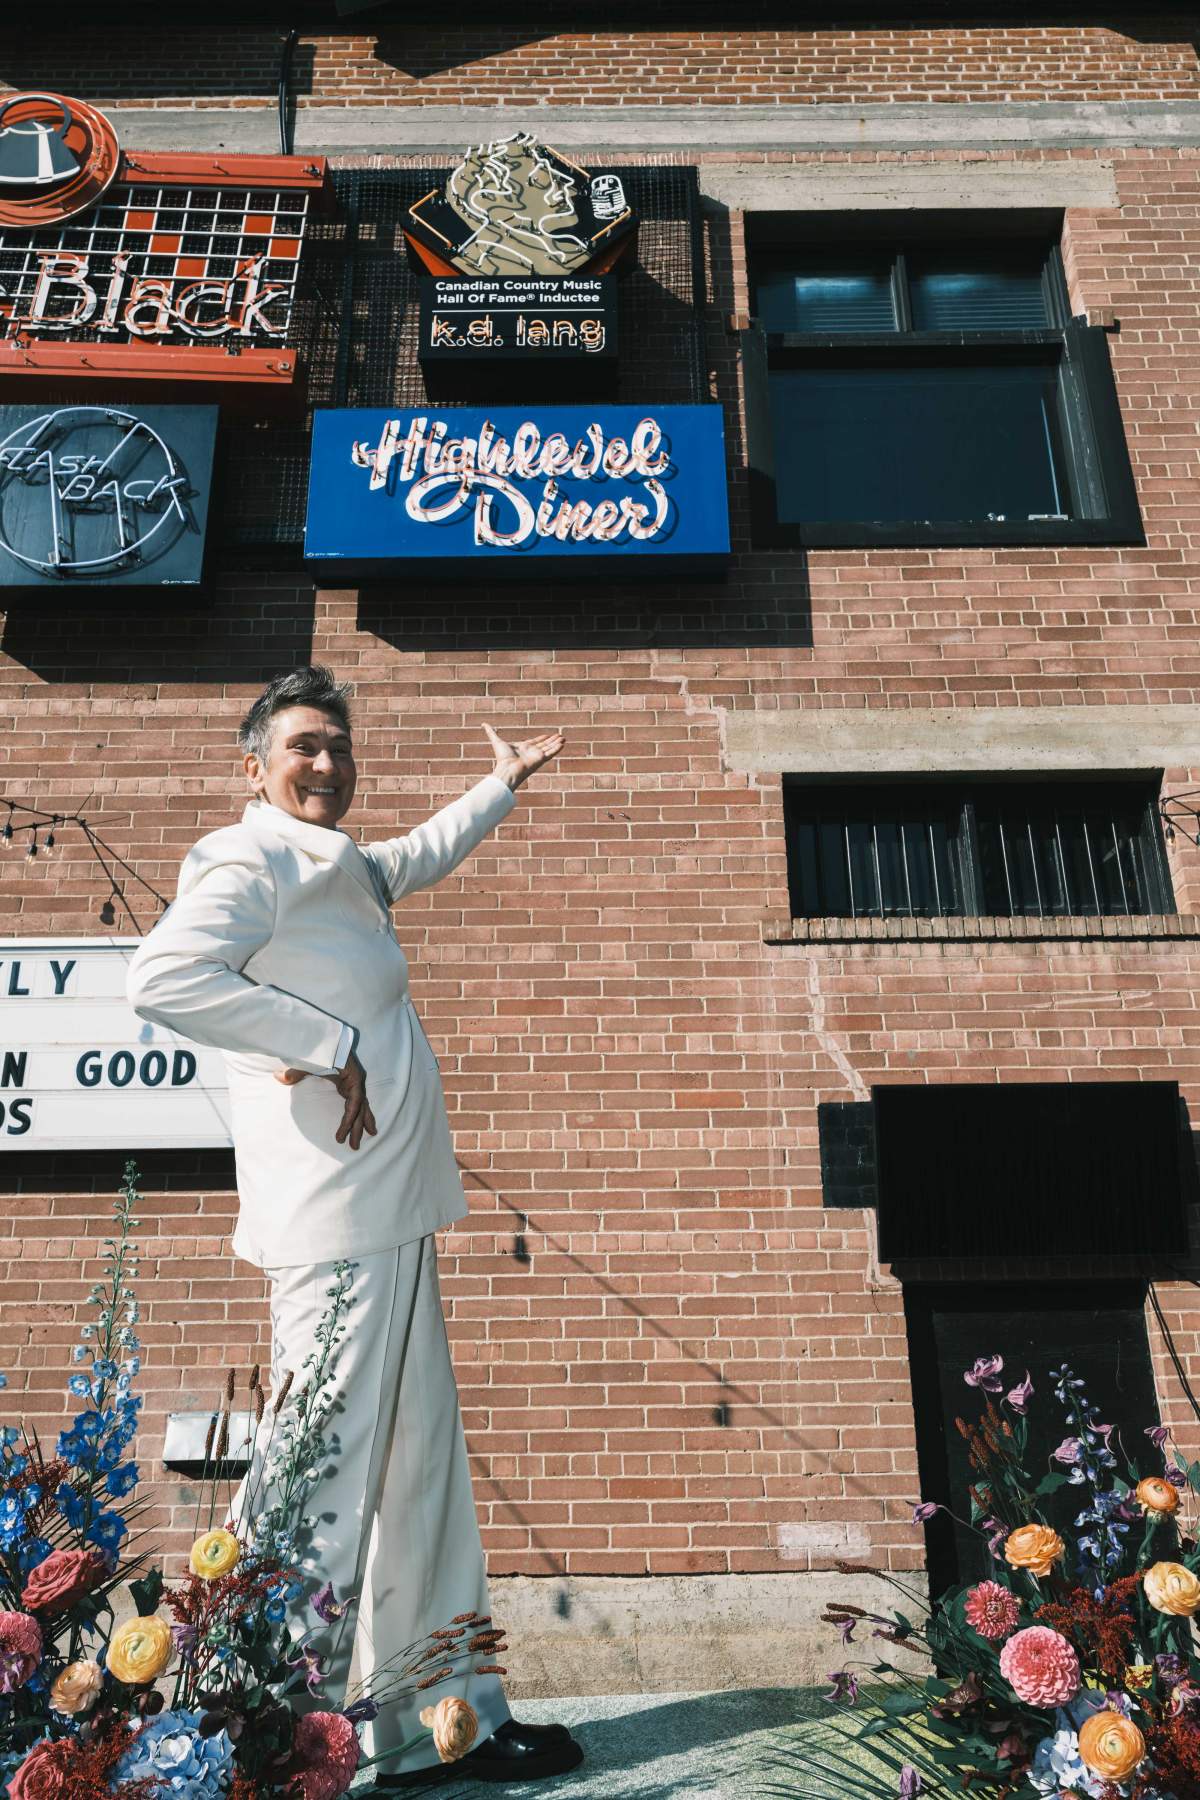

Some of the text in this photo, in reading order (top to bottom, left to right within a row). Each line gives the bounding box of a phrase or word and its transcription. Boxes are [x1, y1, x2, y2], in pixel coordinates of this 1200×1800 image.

[21, 250, 288, 338] Black
[435, 280, 602, 291] Canadian Country Music
[437, 294, 464, 304] Hall
[468, 294, 485, 303] Of
[539, 293, 600, 303] Inductee
[430, 314, 605, 352] k.d. lang
[58, 474, 186, 508] BACK
[406, 470, 669, 547] Diner
[0, 960, 76, 996] LY
[76, 1050, 196, 1088] GOOD
[0, 1098, 33, 1136] S
